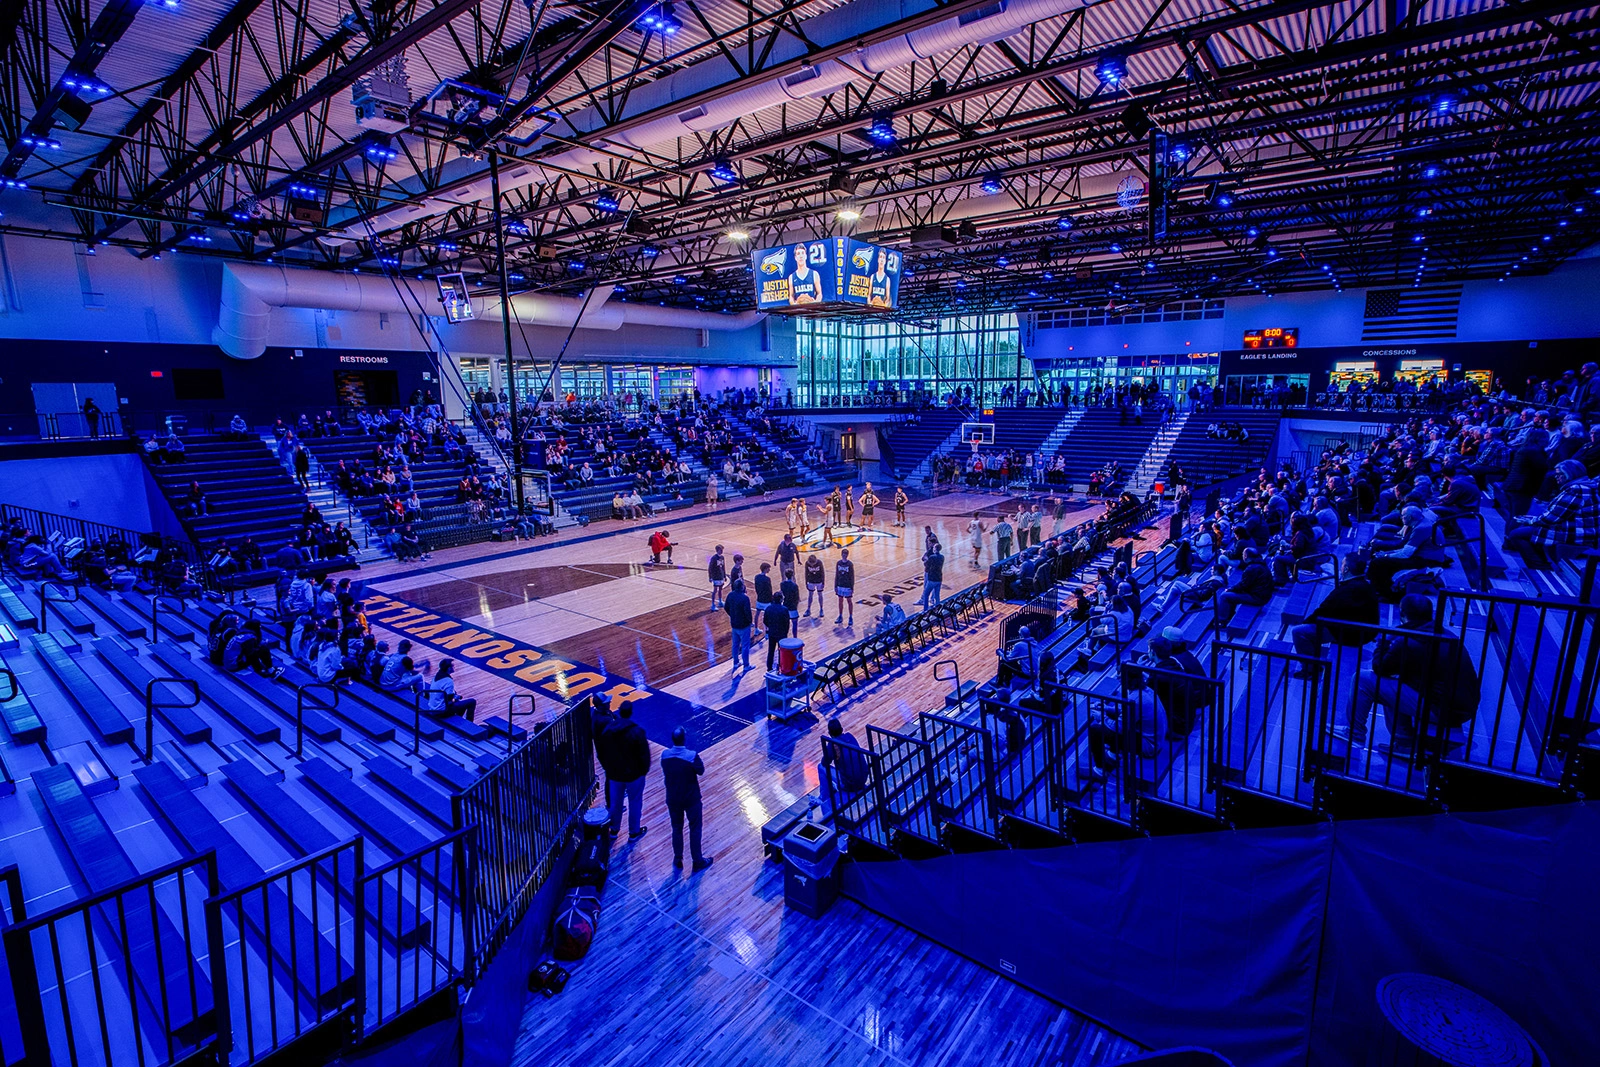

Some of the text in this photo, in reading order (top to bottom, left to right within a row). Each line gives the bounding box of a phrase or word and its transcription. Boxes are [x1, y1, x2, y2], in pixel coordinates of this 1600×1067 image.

[809, 243, 827, 265] 21
[836, 238, 844, 295] EAGLES
[886, 251, 899, 272] 21
[763, 278, 789, 292] JUSTIN
[850, 273, 870, 287] JUSTIN
[848, 284, 870, 298] FISHER
[1264, 328, 1282, 337] 8:00
[340, 355, 389, 364] RESTROOMS
[1362, 349, 1417, 357] CONCESSIONS
